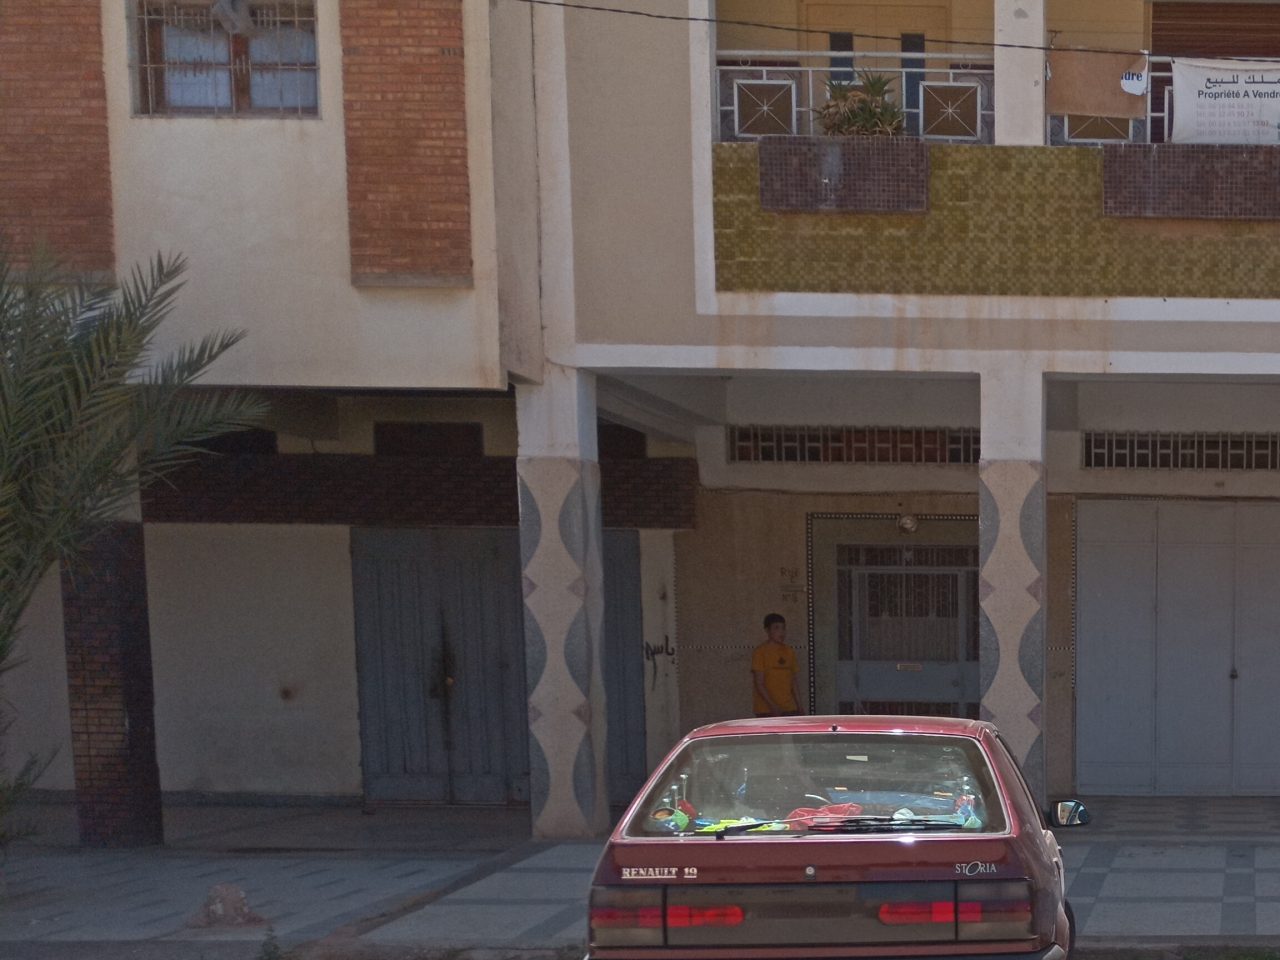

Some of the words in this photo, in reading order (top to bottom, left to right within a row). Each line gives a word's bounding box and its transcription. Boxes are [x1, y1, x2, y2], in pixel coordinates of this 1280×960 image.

[1205, 75, 1239, 89] للبيع
[1198, 90, 1240, 100] Propriété
[1243, 90, 1250, 98] A
[622, 867, 678, 878] RENAULT
[683, 867, 698, 878] 19
[955, 861, 997, 876] STORIA
